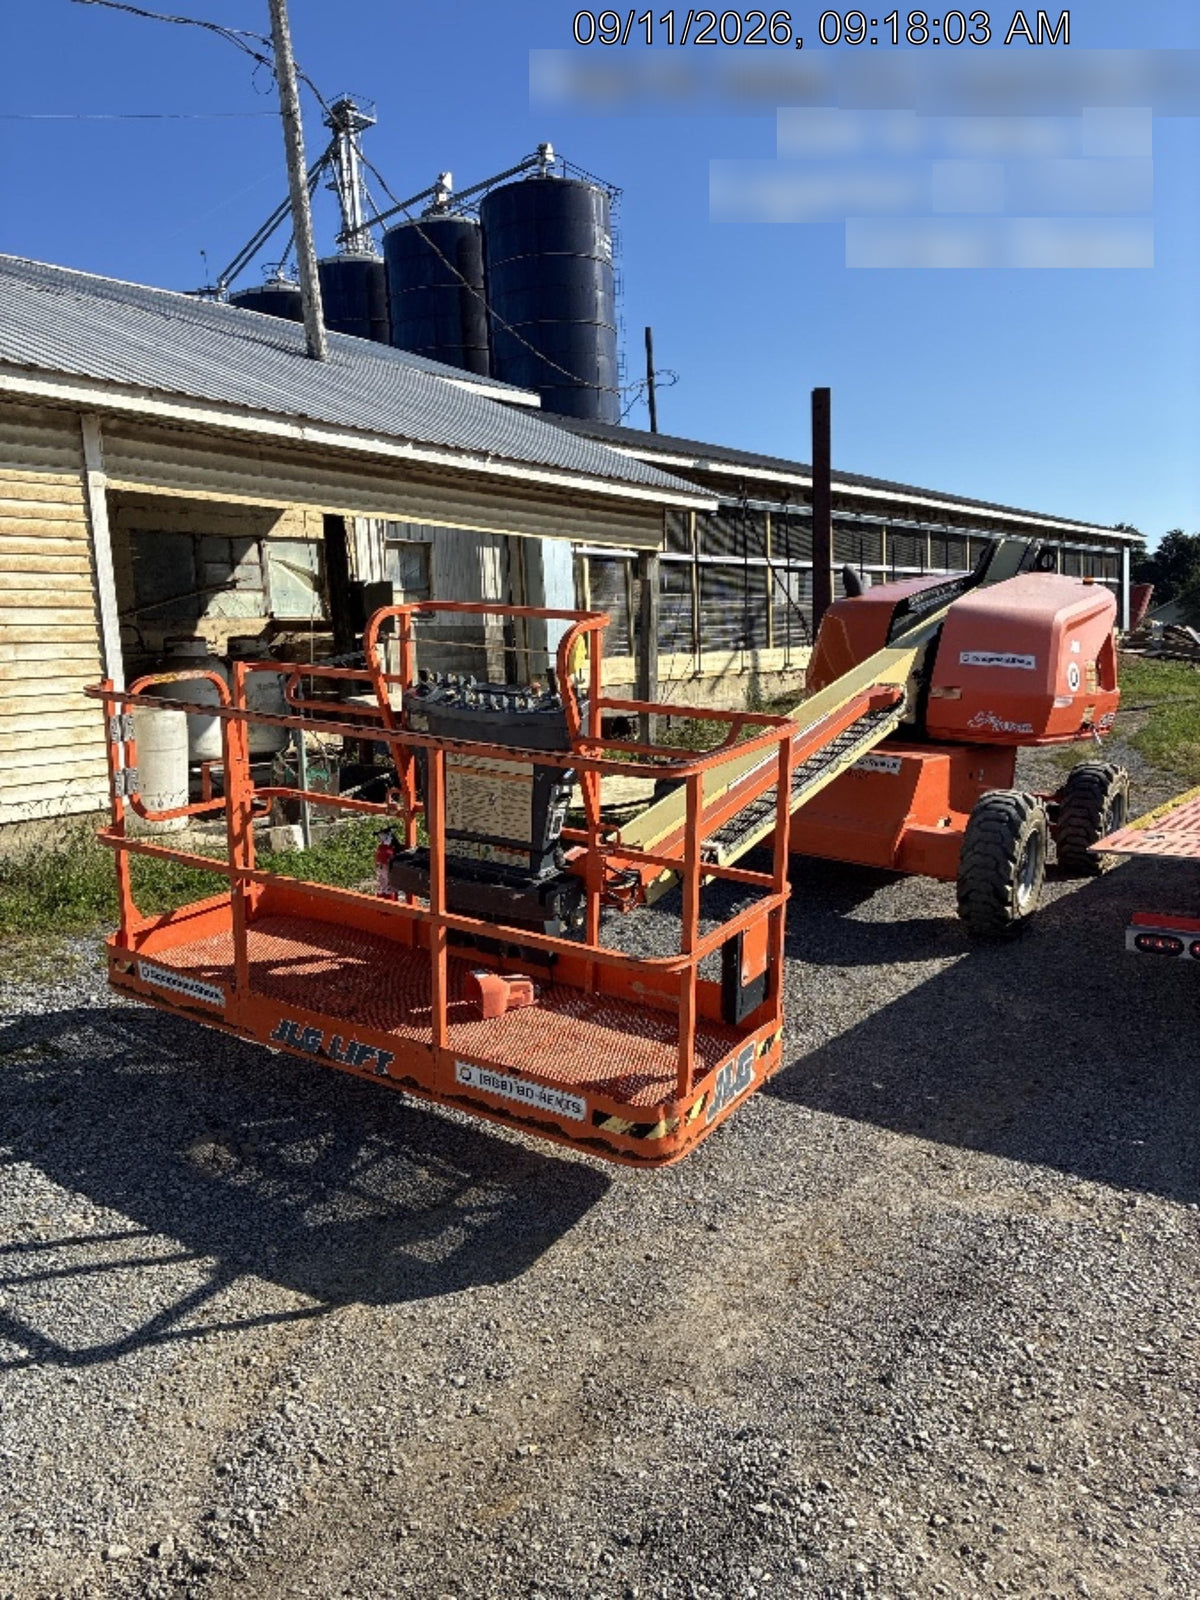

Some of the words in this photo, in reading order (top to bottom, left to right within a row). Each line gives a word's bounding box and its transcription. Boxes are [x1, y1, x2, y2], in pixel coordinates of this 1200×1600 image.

[270, 1019, 324, 1052] JLG
[327, 1034, 395, 1075] LIFT
[706, 1040, 756, 1124] JLG
